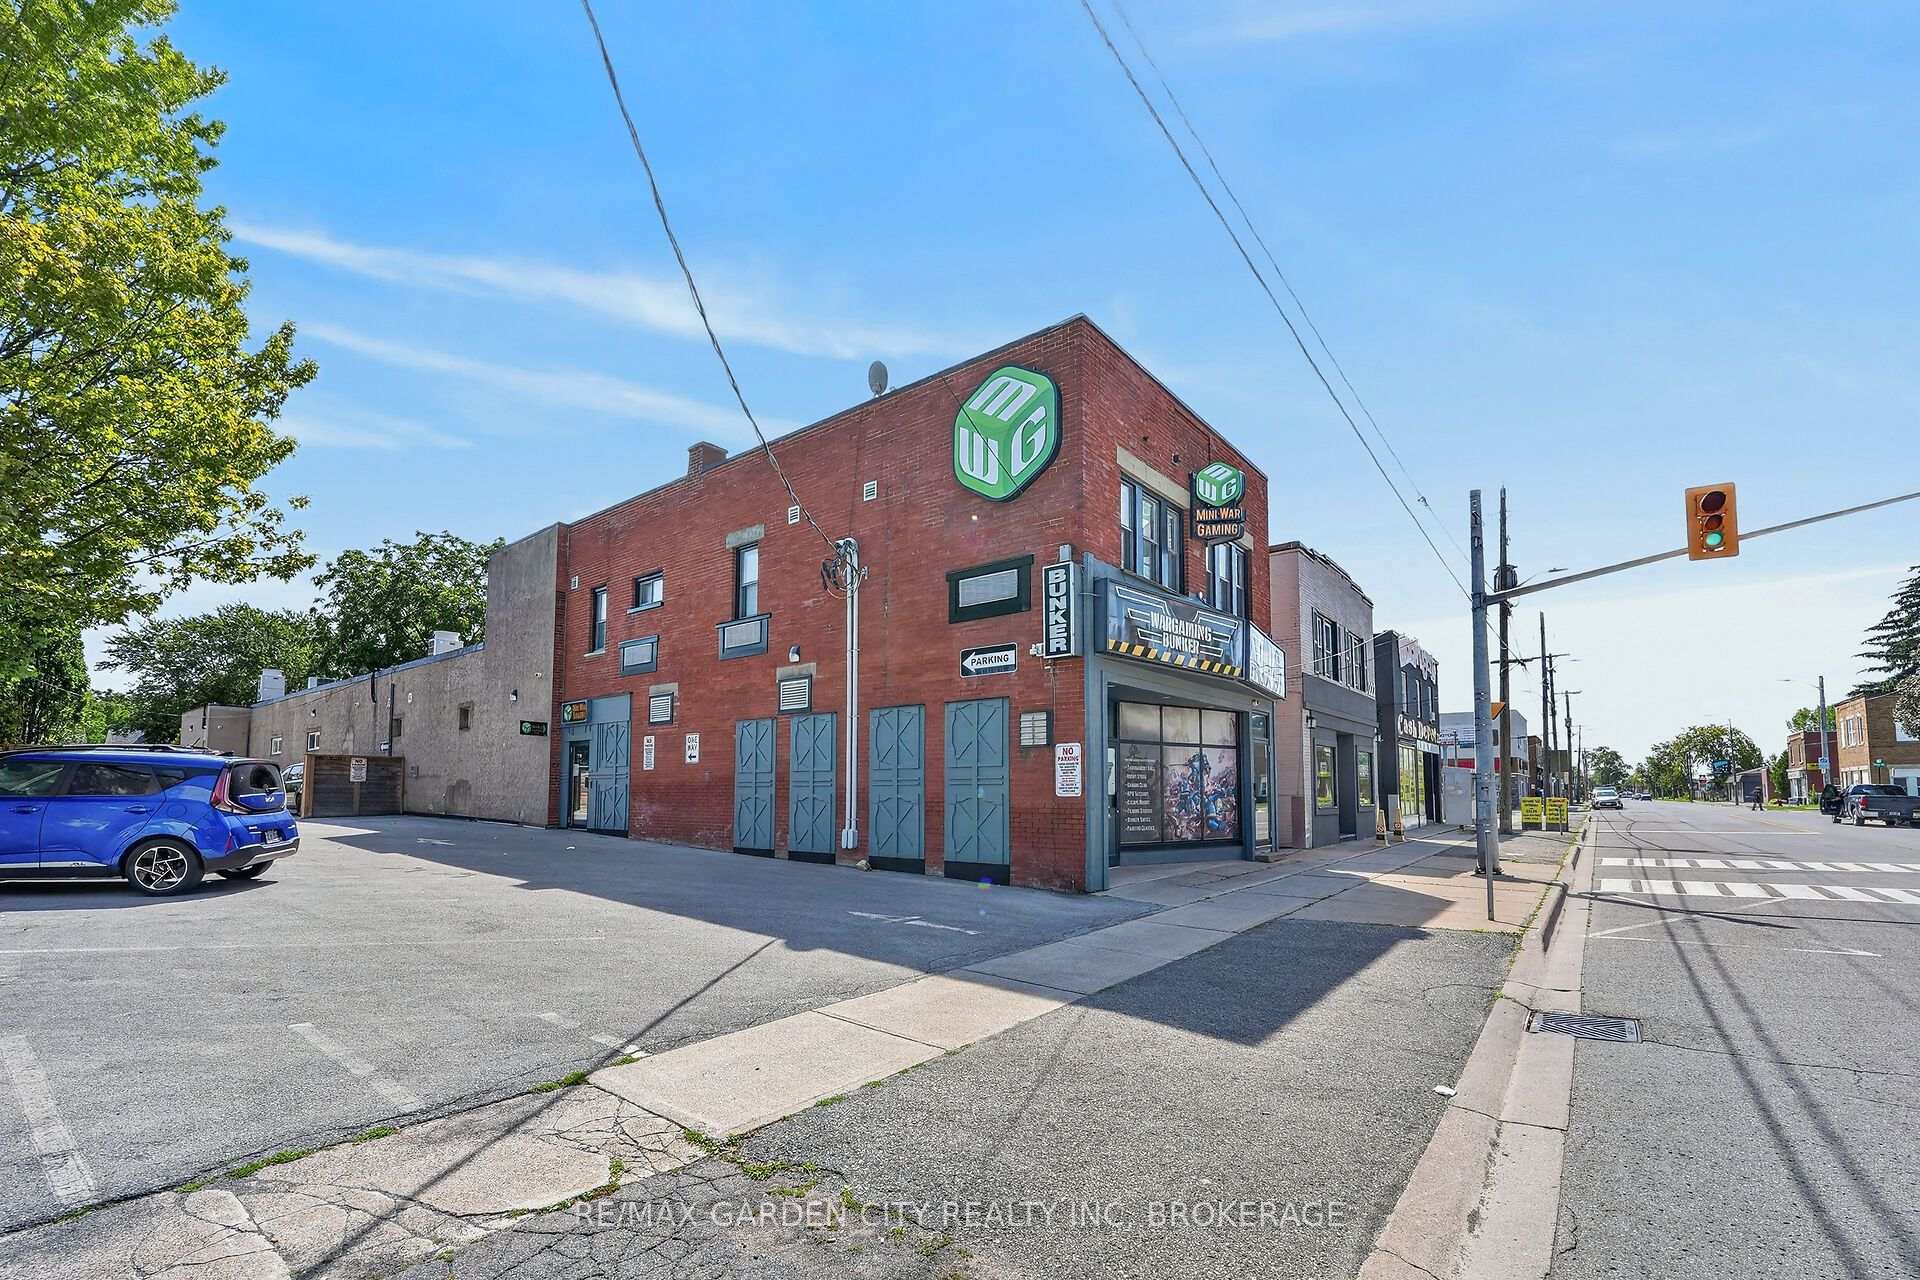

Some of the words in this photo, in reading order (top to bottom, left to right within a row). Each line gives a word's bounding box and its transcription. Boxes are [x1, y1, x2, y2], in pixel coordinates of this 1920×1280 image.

[1197, 524, 1238, 536] GAMING
[1048, 568, 1067, 653] BUNKER
[1150, 611, 1212, 642] WARGAMING
[1162, 631, 1200, 654] BUNKER
[970, 654, 1009, 667] PARKING
[1397, 713, 1417, 739] Cash
[1062, 747, 1073, 755] NO
